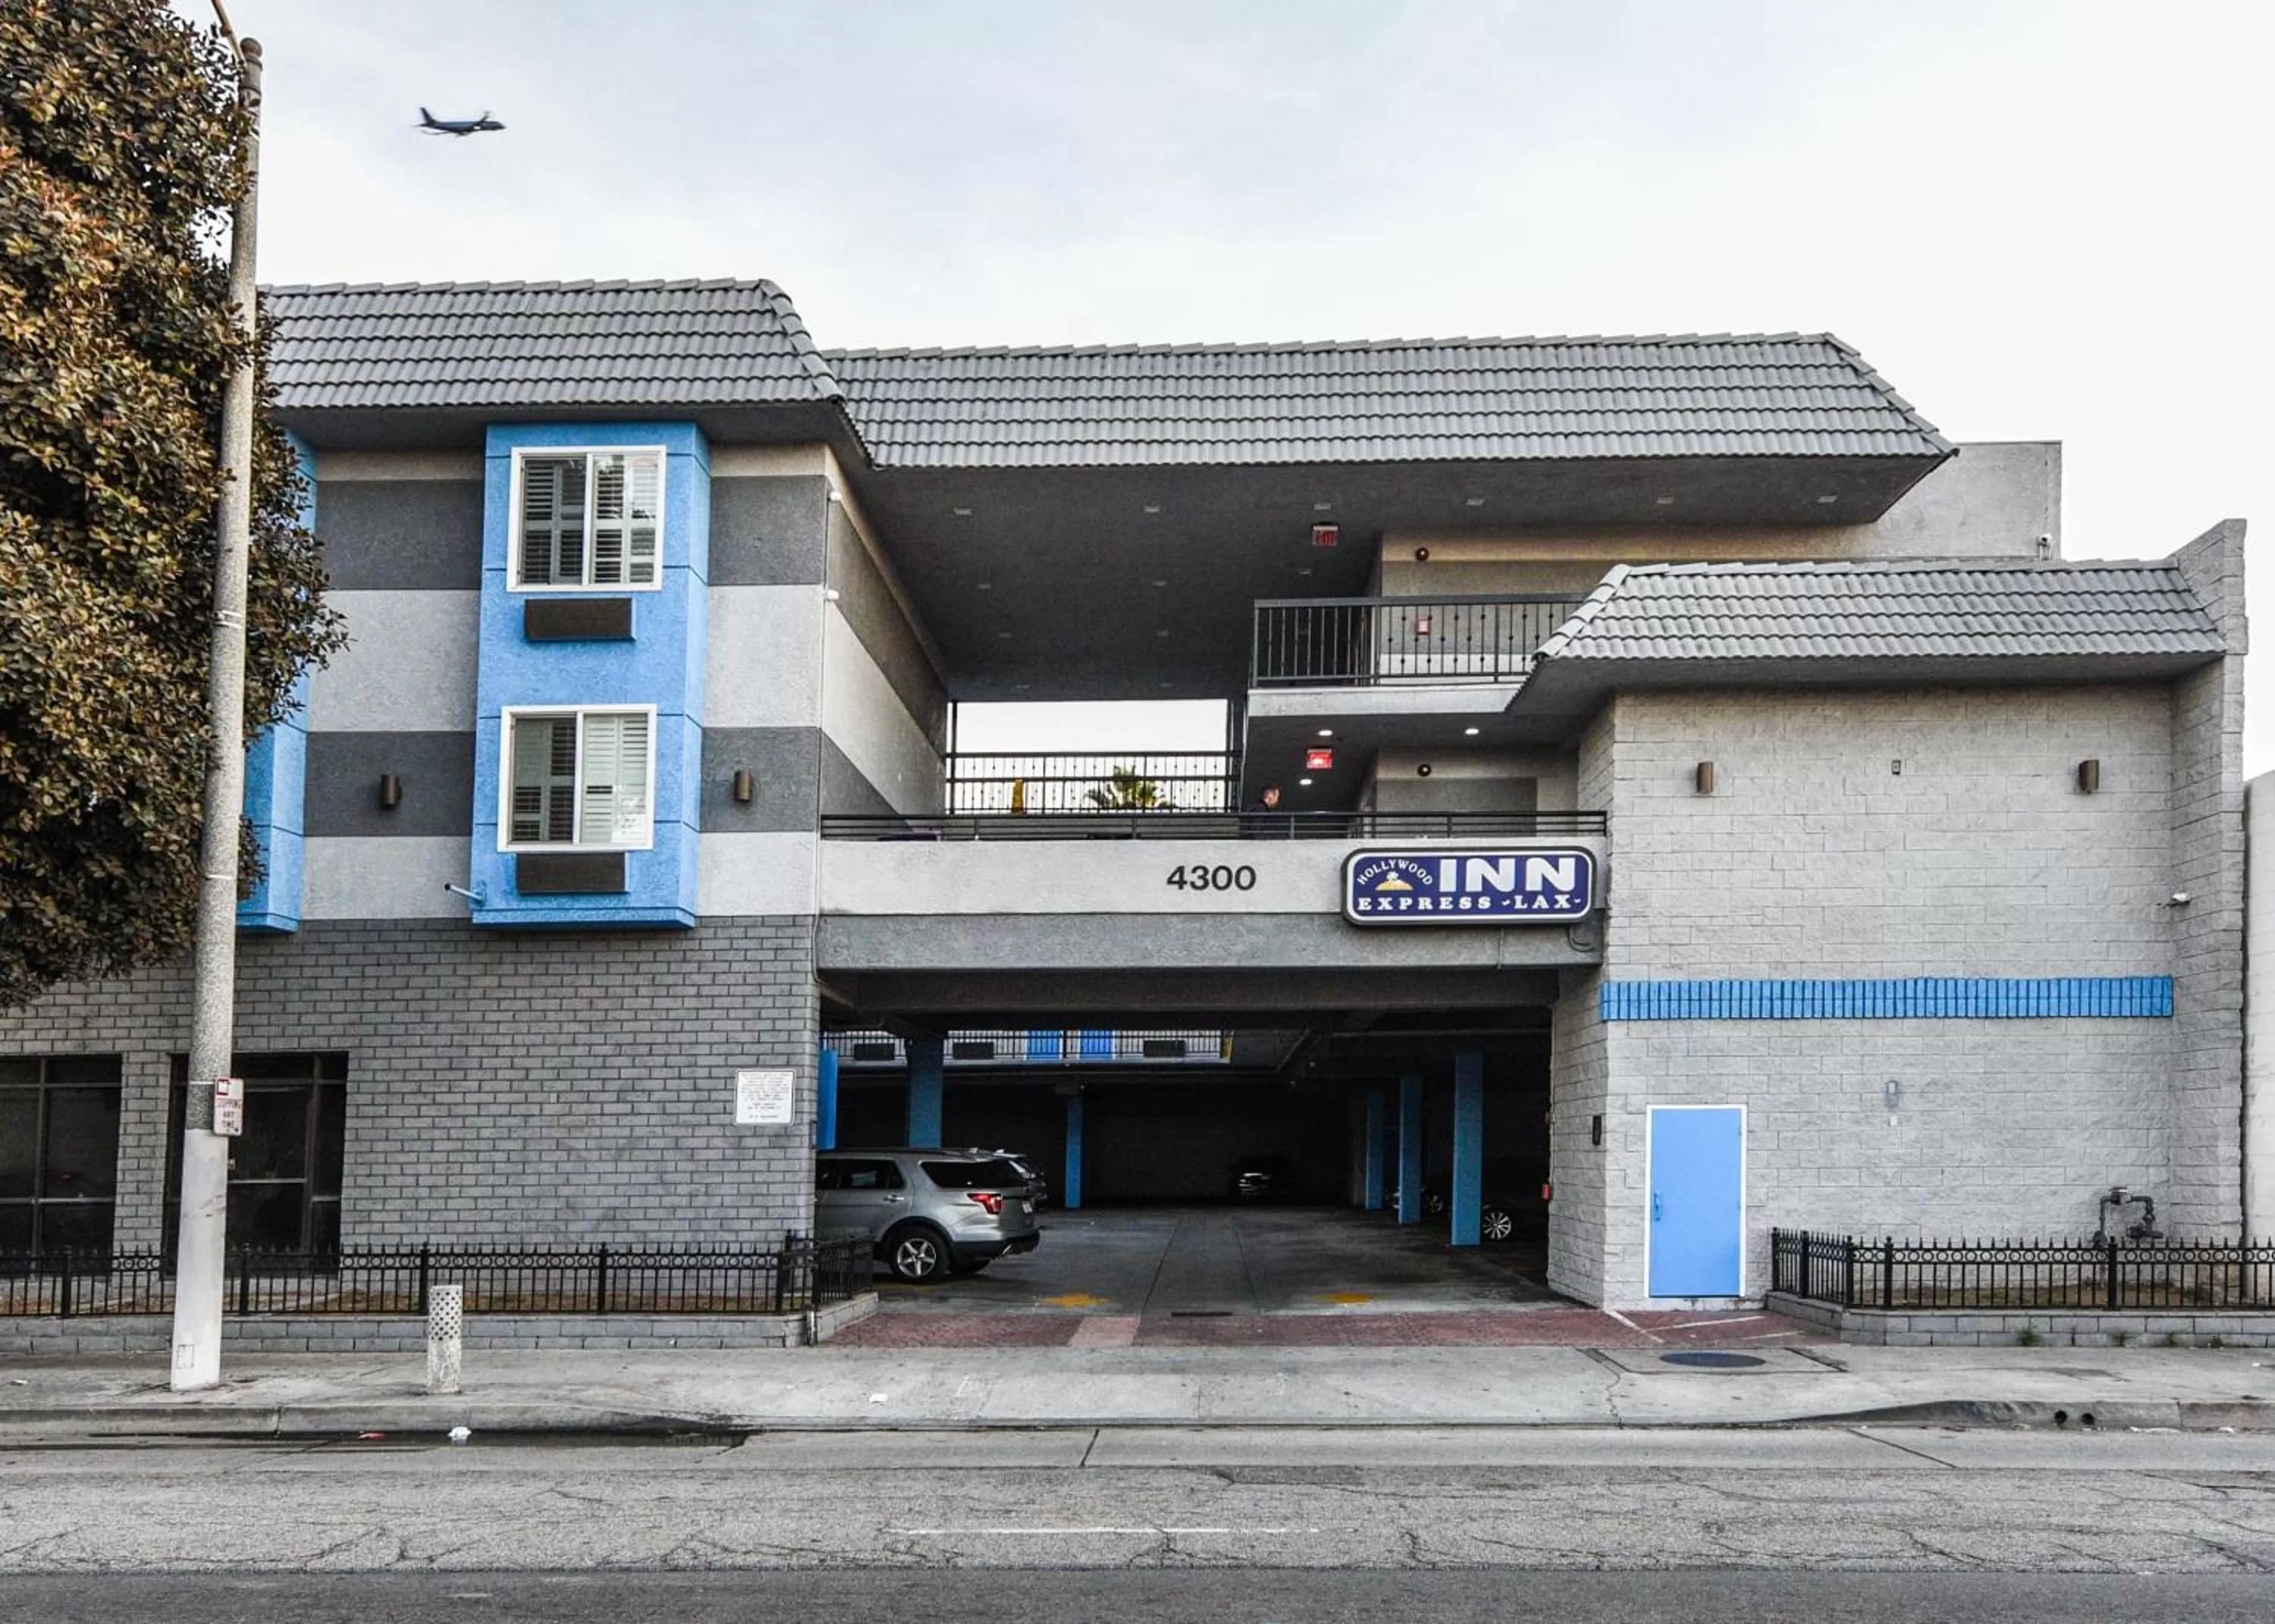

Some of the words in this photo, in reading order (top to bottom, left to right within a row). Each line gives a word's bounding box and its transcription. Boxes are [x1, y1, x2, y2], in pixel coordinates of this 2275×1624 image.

[1166, 865, 1257, 891] 4300
[1357, 858, 1432, 886] HOLLYWOOD
[1439, 857, 1576, 892] INN
[1357, 896, 1492, 911] EXPRESS
